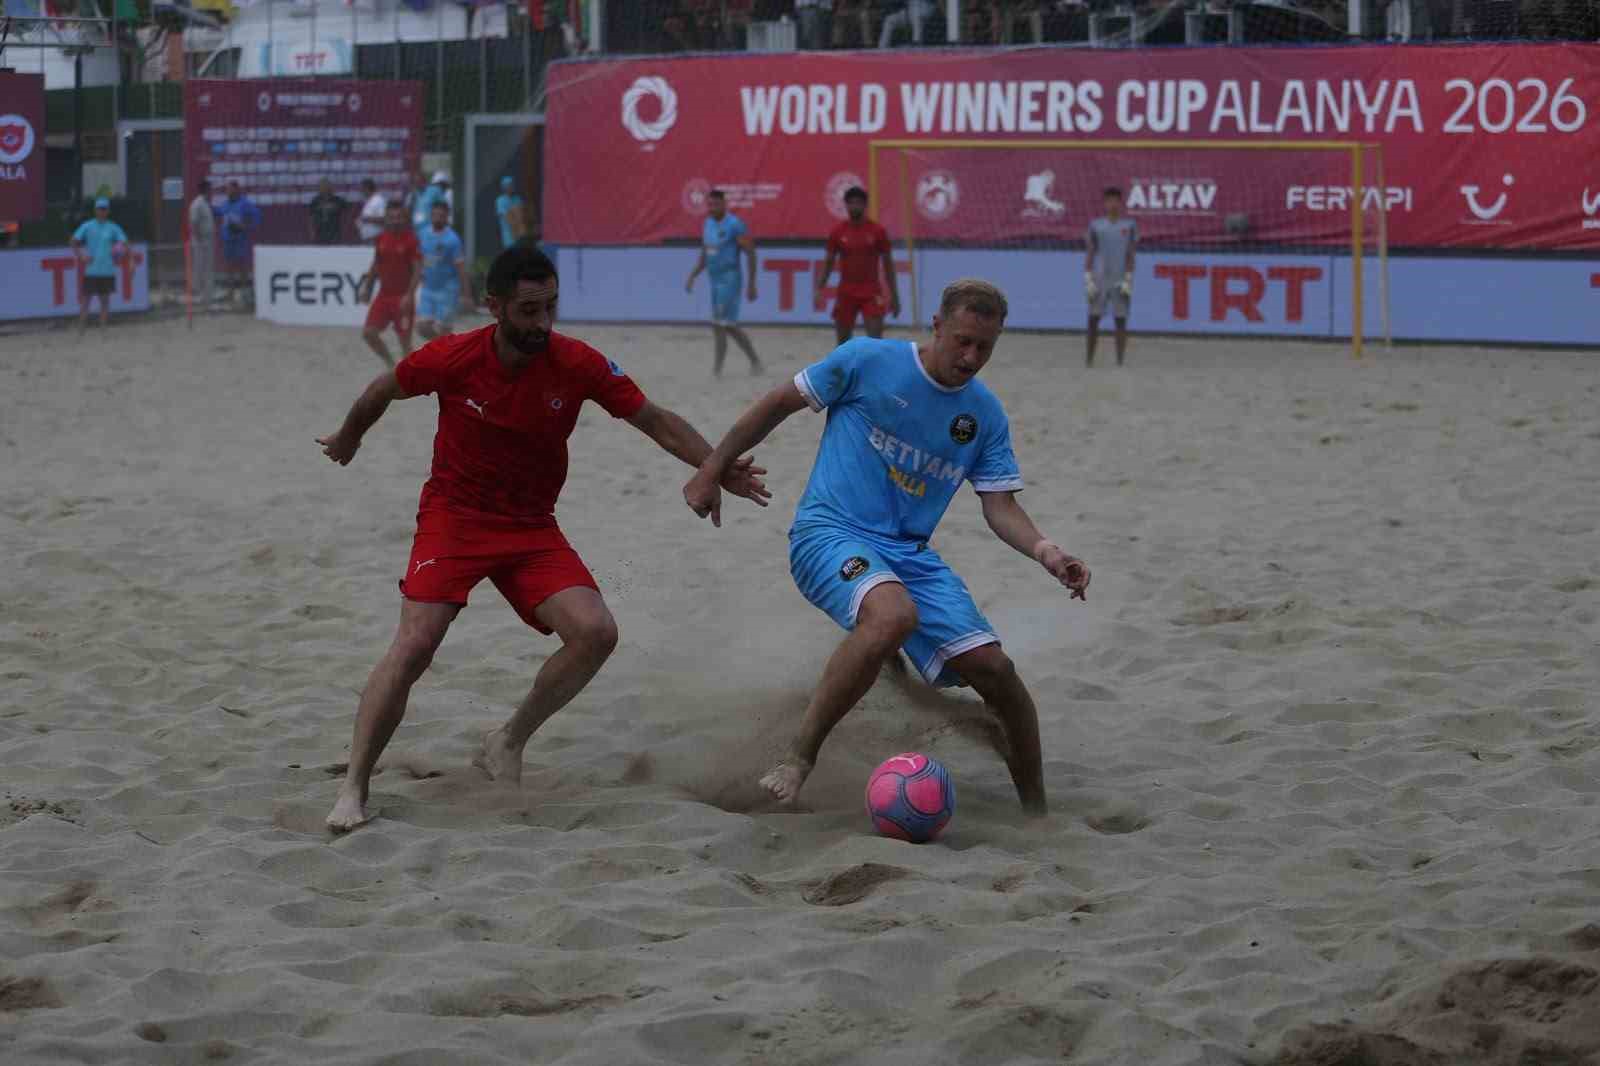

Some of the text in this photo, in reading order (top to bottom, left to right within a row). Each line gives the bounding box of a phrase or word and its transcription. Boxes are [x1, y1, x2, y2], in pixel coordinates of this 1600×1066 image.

[294, 52, 327, 69] TRT
[740, 78, 1587, 136] WORLD WINNERS CUP ALANYA 2026
[1126, 184, 1218, 209] ALTAV
[42, 252, 144, 305] TT
[270, 271, 378, 305] FERY
[1153, 264, 1323, 323] TRT
